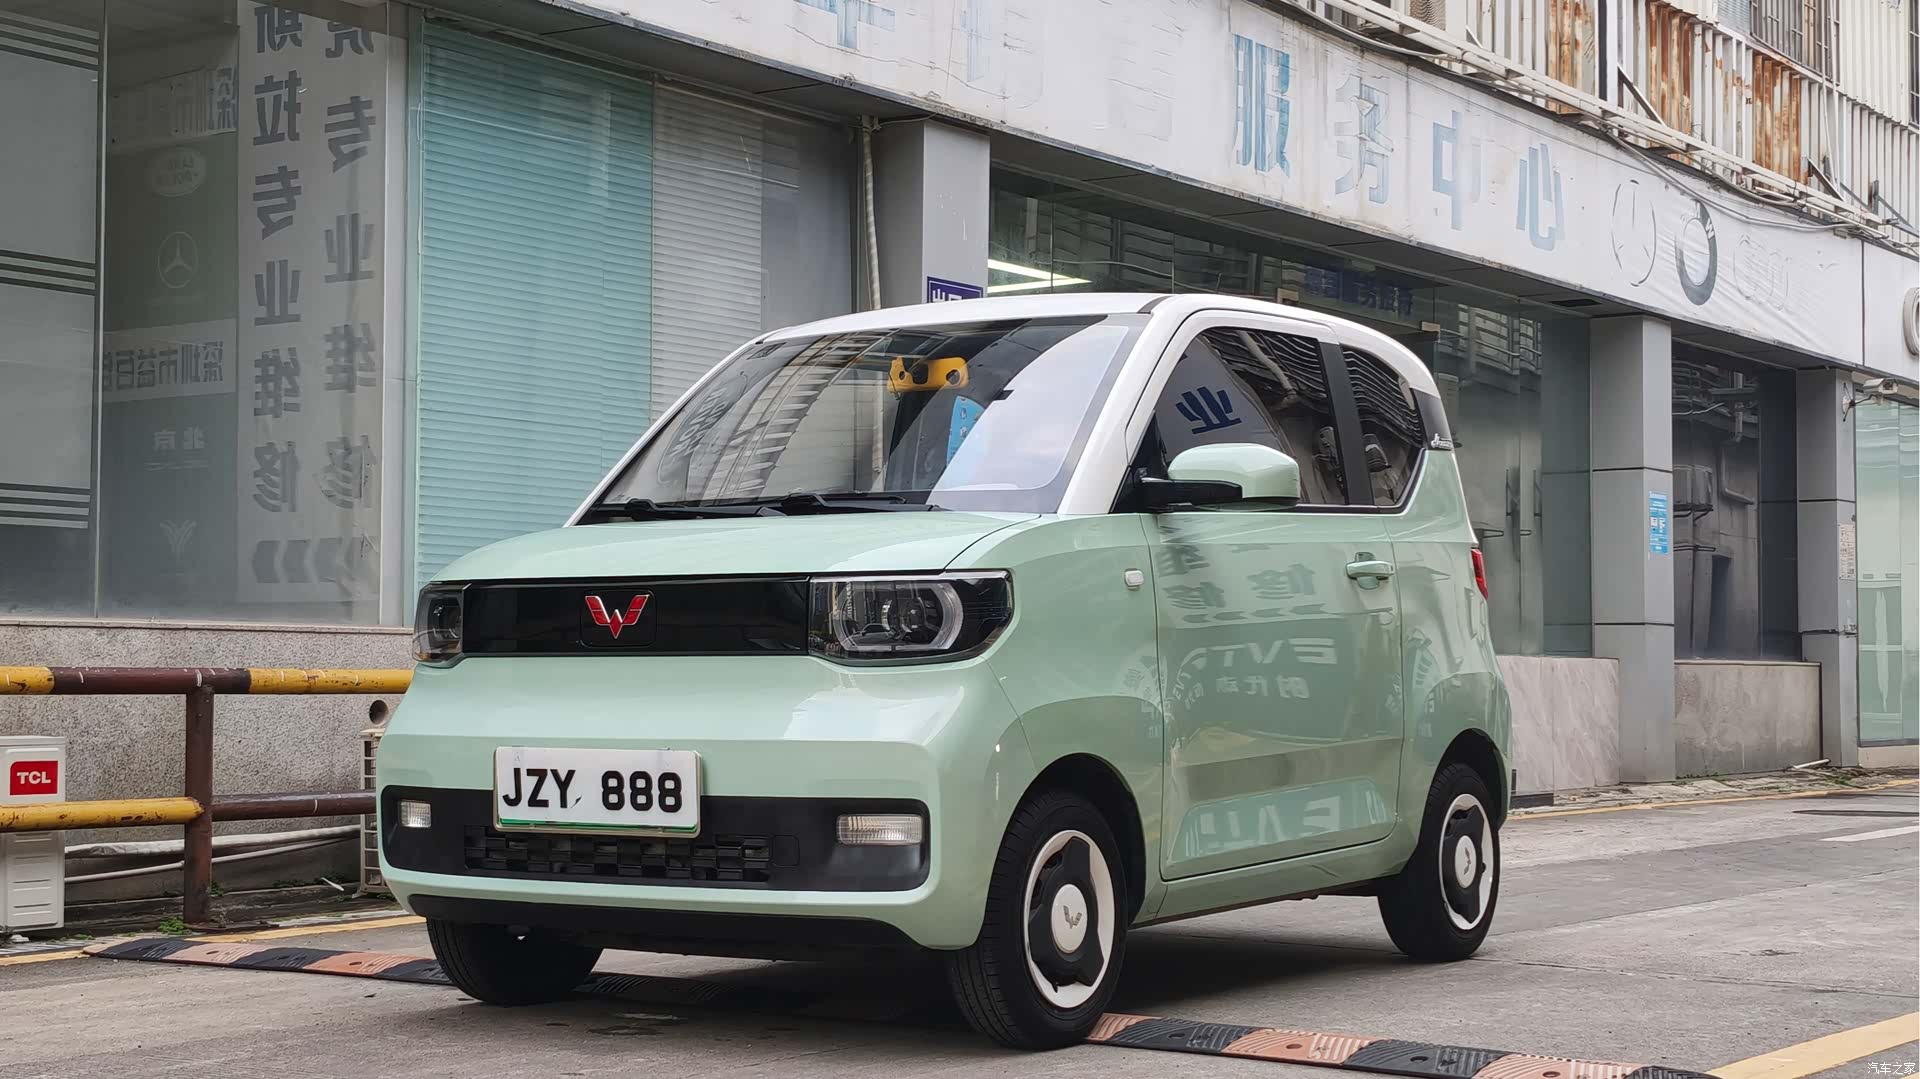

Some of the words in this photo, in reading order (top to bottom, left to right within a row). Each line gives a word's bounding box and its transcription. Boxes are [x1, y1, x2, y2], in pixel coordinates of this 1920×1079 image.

[1233, 34, 1566, 251] 服务中心
[16, 770, 52, 785] TCL
[502, 767, 576, 809] JZY
[601, 770, 683, 814] 888
